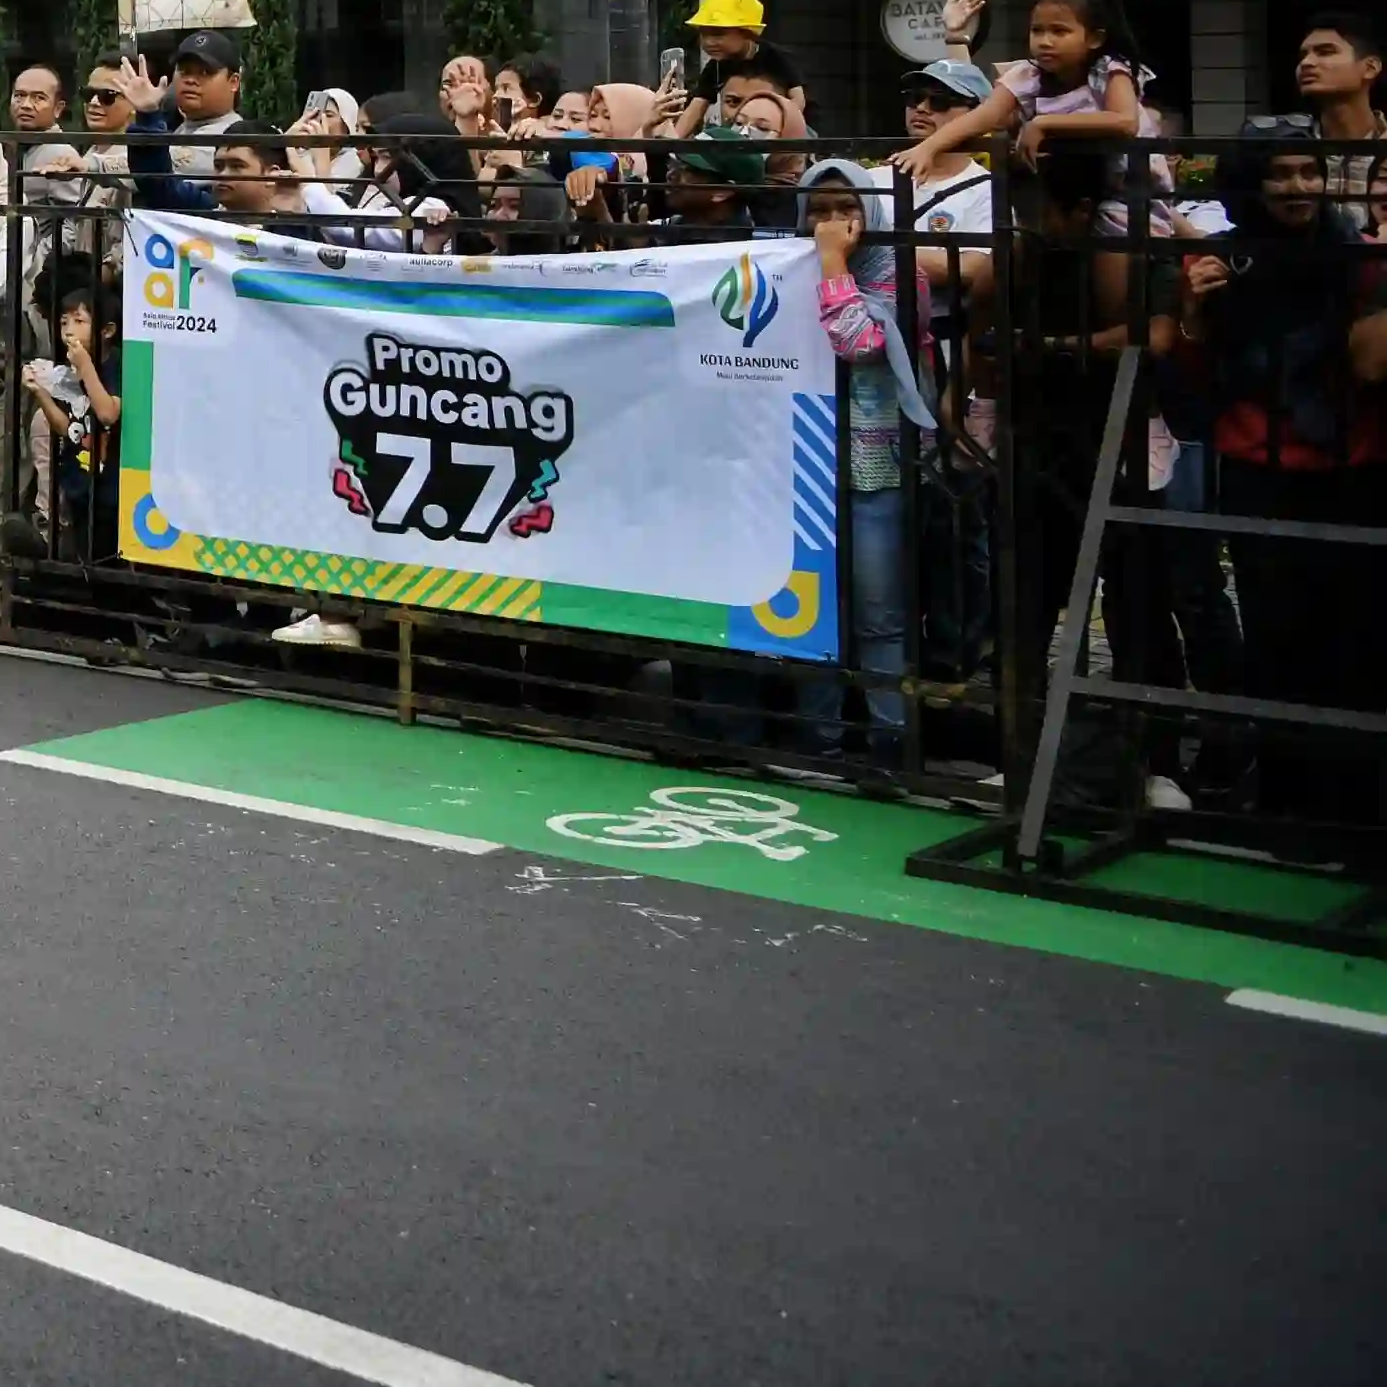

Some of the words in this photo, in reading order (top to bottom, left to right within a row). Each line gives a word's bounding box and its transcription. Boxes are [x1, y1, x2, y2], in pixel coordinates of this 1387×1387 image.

[890, 0, 944, 17] BATAV
[908, 16, 946, 29] CAF
[142, 320, 175, 330] Festival
[176, 315, 217, 334] 2024
[374, 336, 503, 384] Promo
[700, 354, 732, 366] KOTA
[734, 356, 799, 370] BANDUNG
[329, 371, 570, 441] Guncang
[374, 432, 517, 535] 7.7
